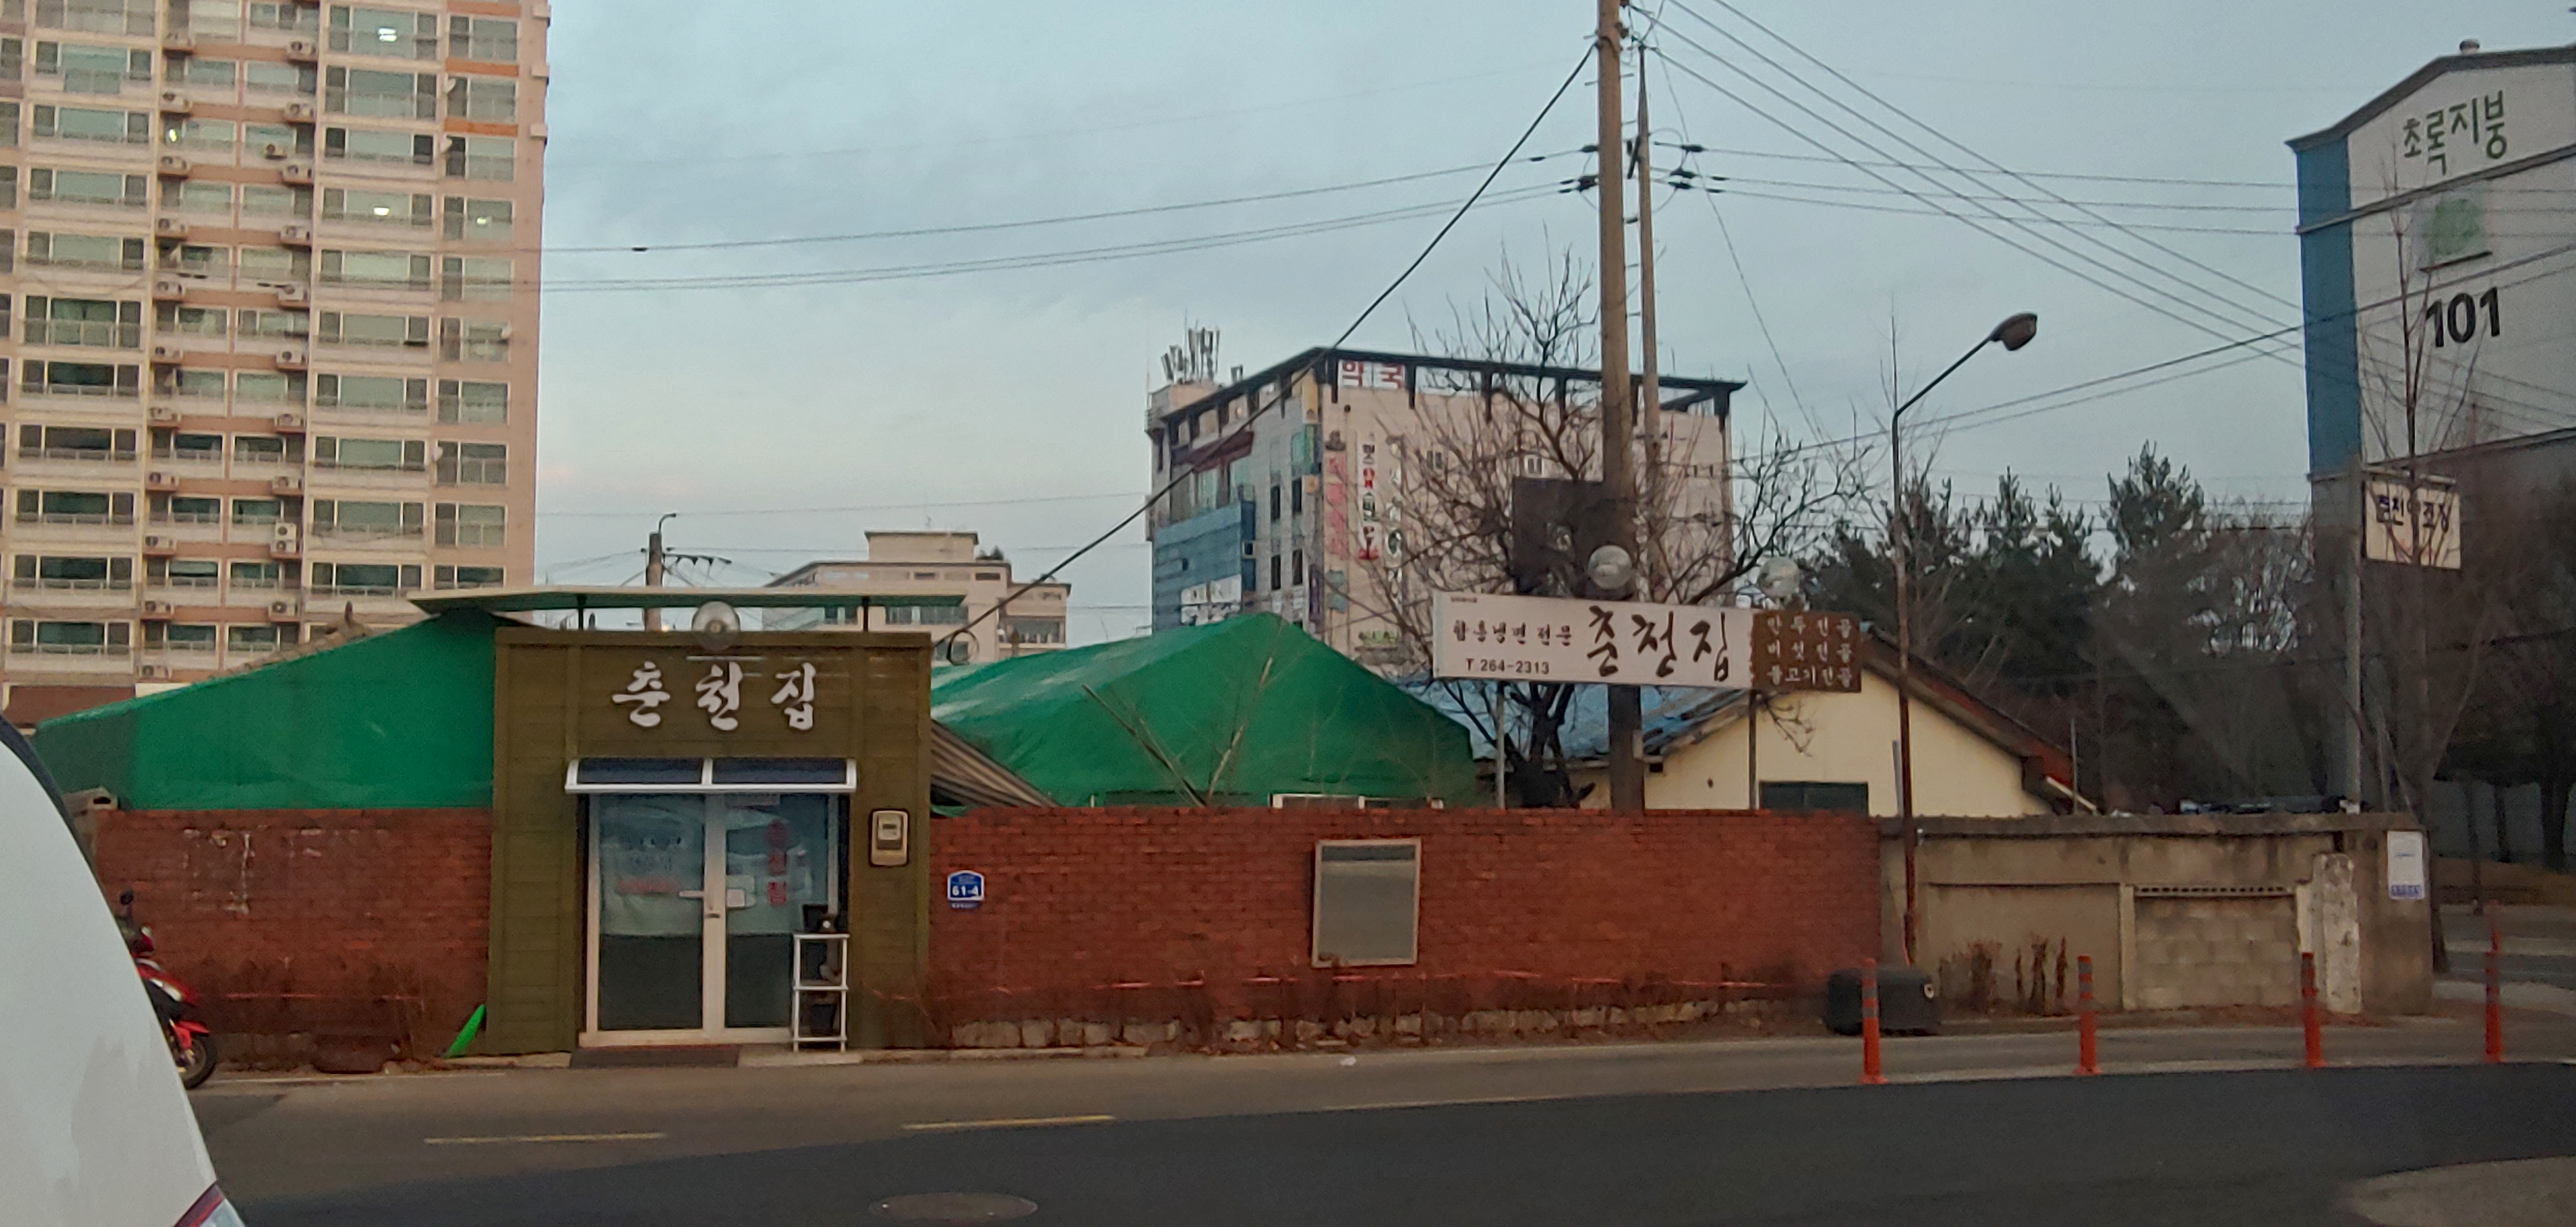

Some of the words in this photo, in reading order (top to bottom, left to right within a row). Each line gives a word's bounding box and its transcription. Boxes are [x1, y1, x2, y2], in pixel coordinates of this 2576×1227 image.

[2403, 90, 2508, 176] 초록지붕
[2426, 287, 2501, 348] 101
[1537, 623, 1573, 647] 전문
[1587, 605, 1729, 682] 춘천집
[612, 661, 817, 731] 춘천집
[1480, 658, 1550, 675] 264-2313
[952, 885, 979, 896] 61-4
